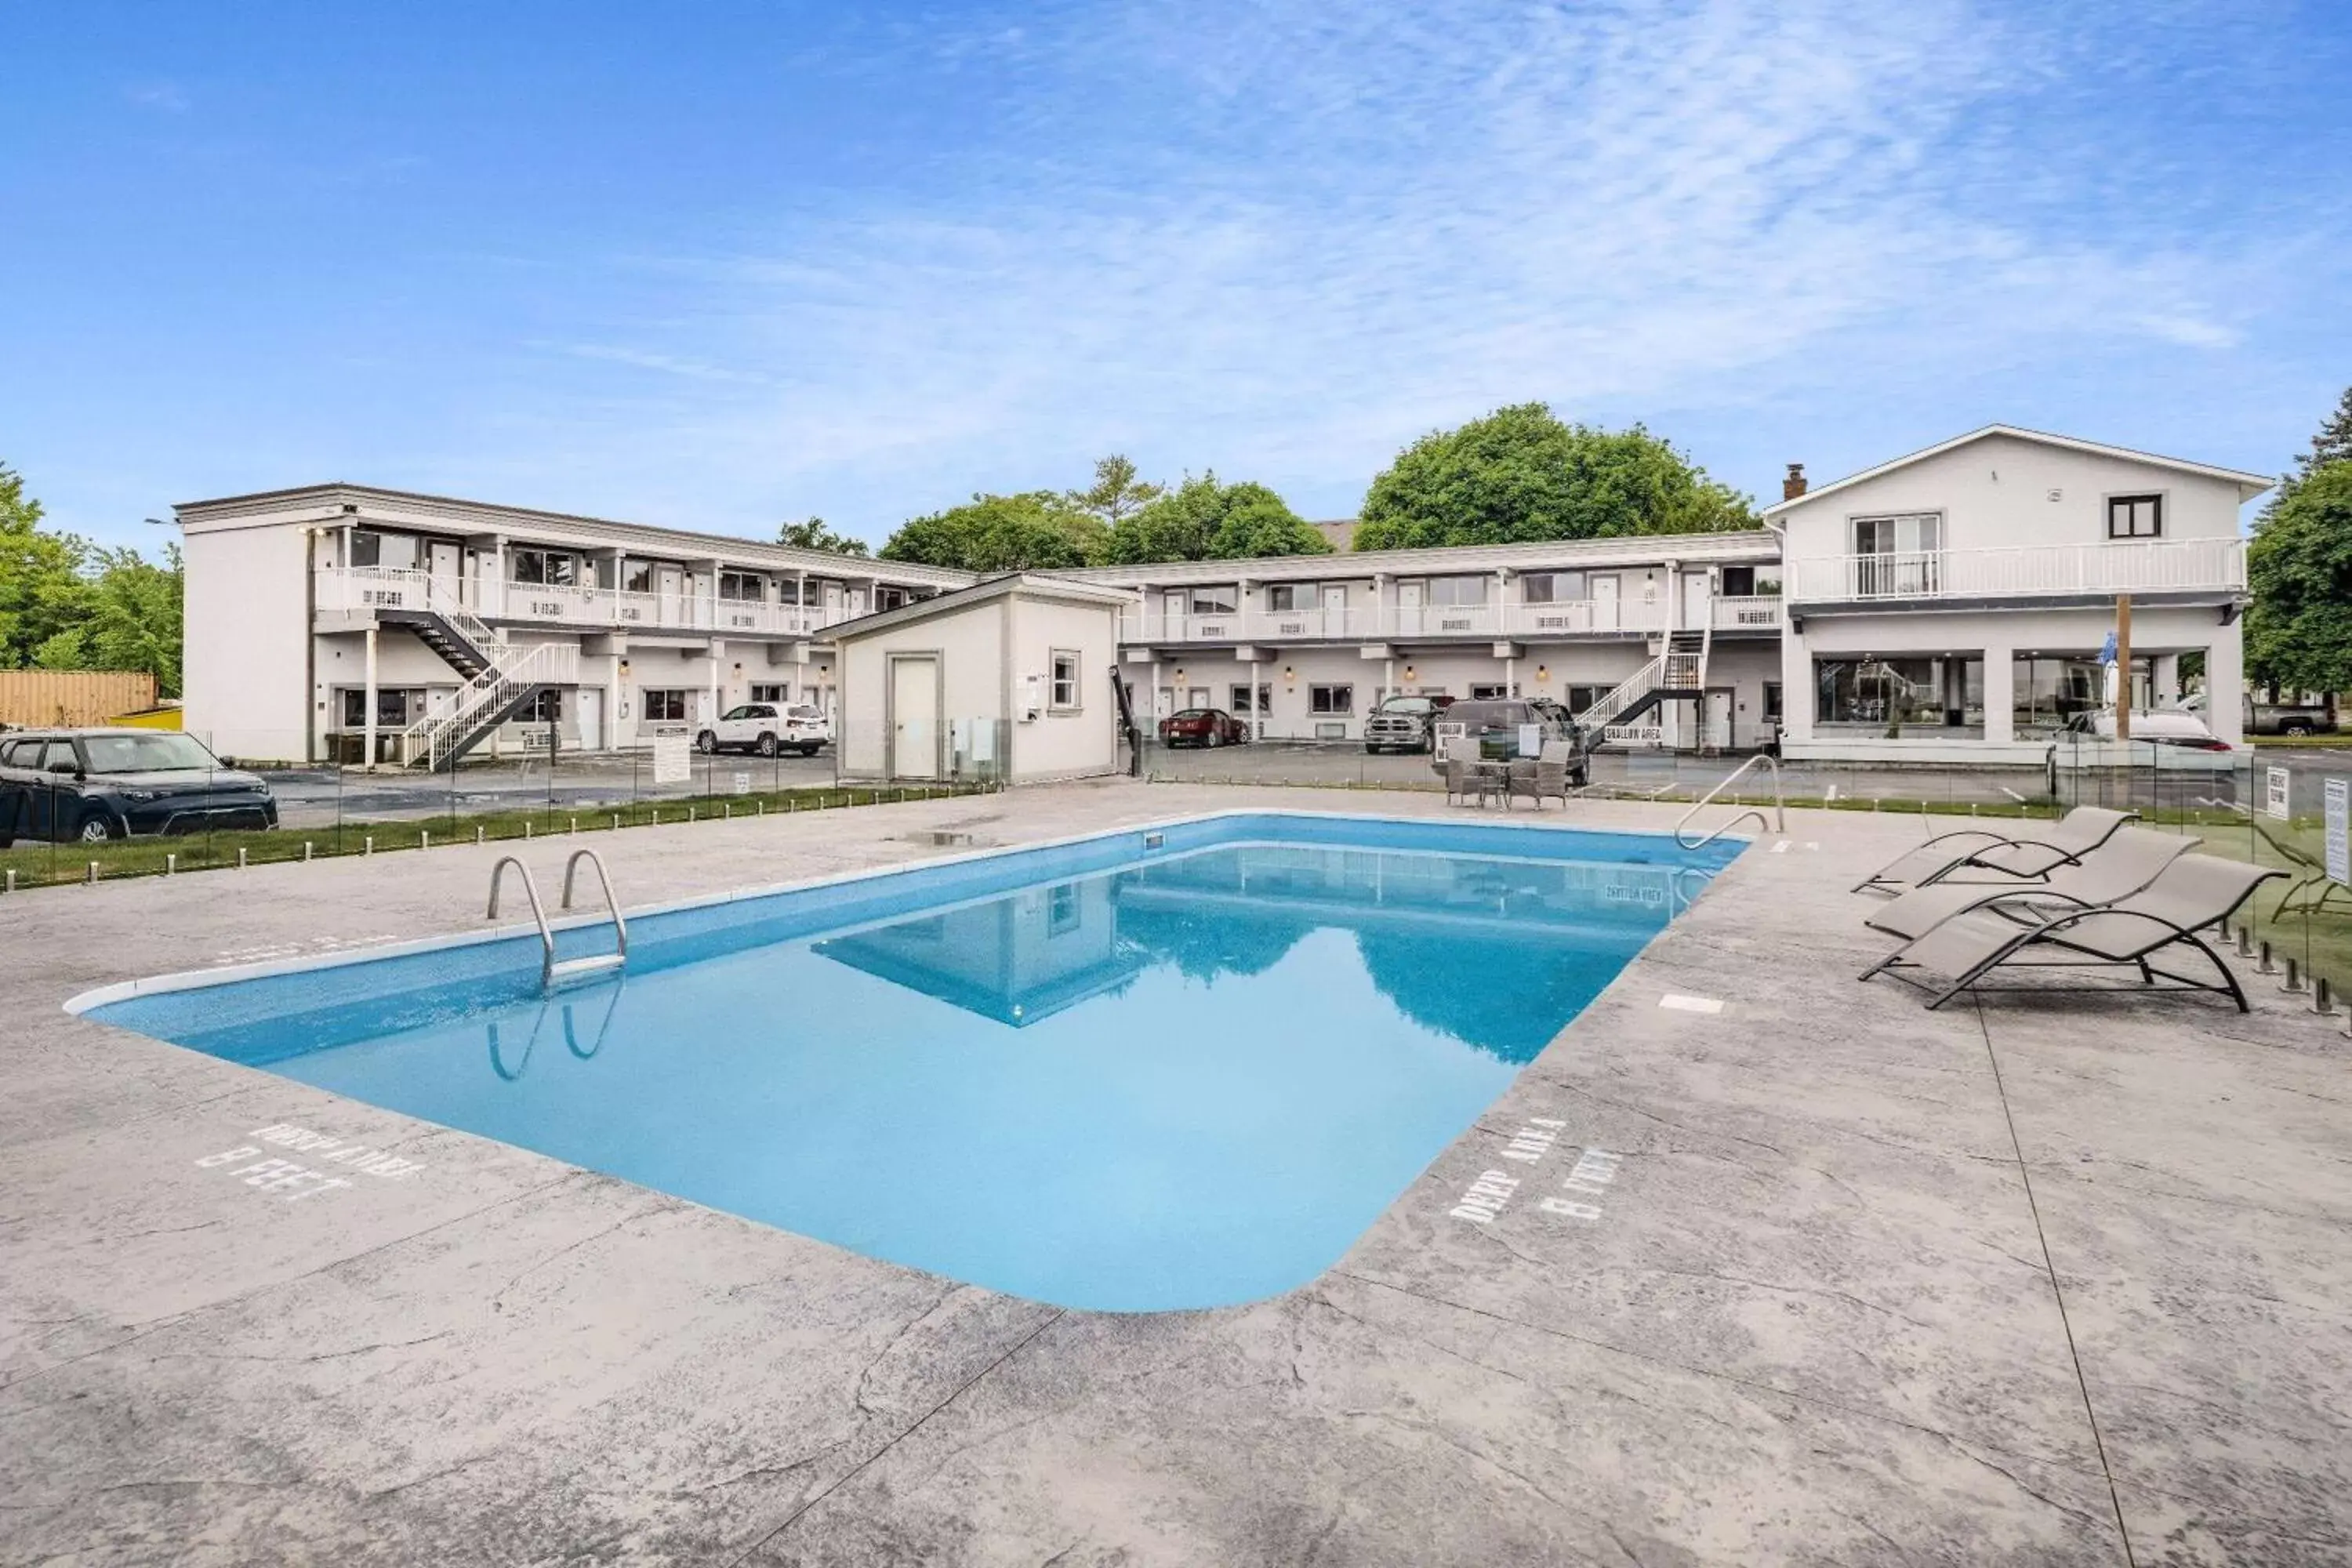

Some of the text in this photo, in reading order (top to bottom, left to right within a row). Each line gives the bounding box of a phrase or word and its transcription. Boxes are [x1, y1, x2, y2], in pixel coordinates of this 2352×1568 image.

[1606, 727, 1661, 741] SHALLOW AREA
[194, 1146, 353, 1202] 8 FEET
[1449, 1118, 1568, 1223] DEEP AREA
[1541, 1197, 1602, 1219] 8
